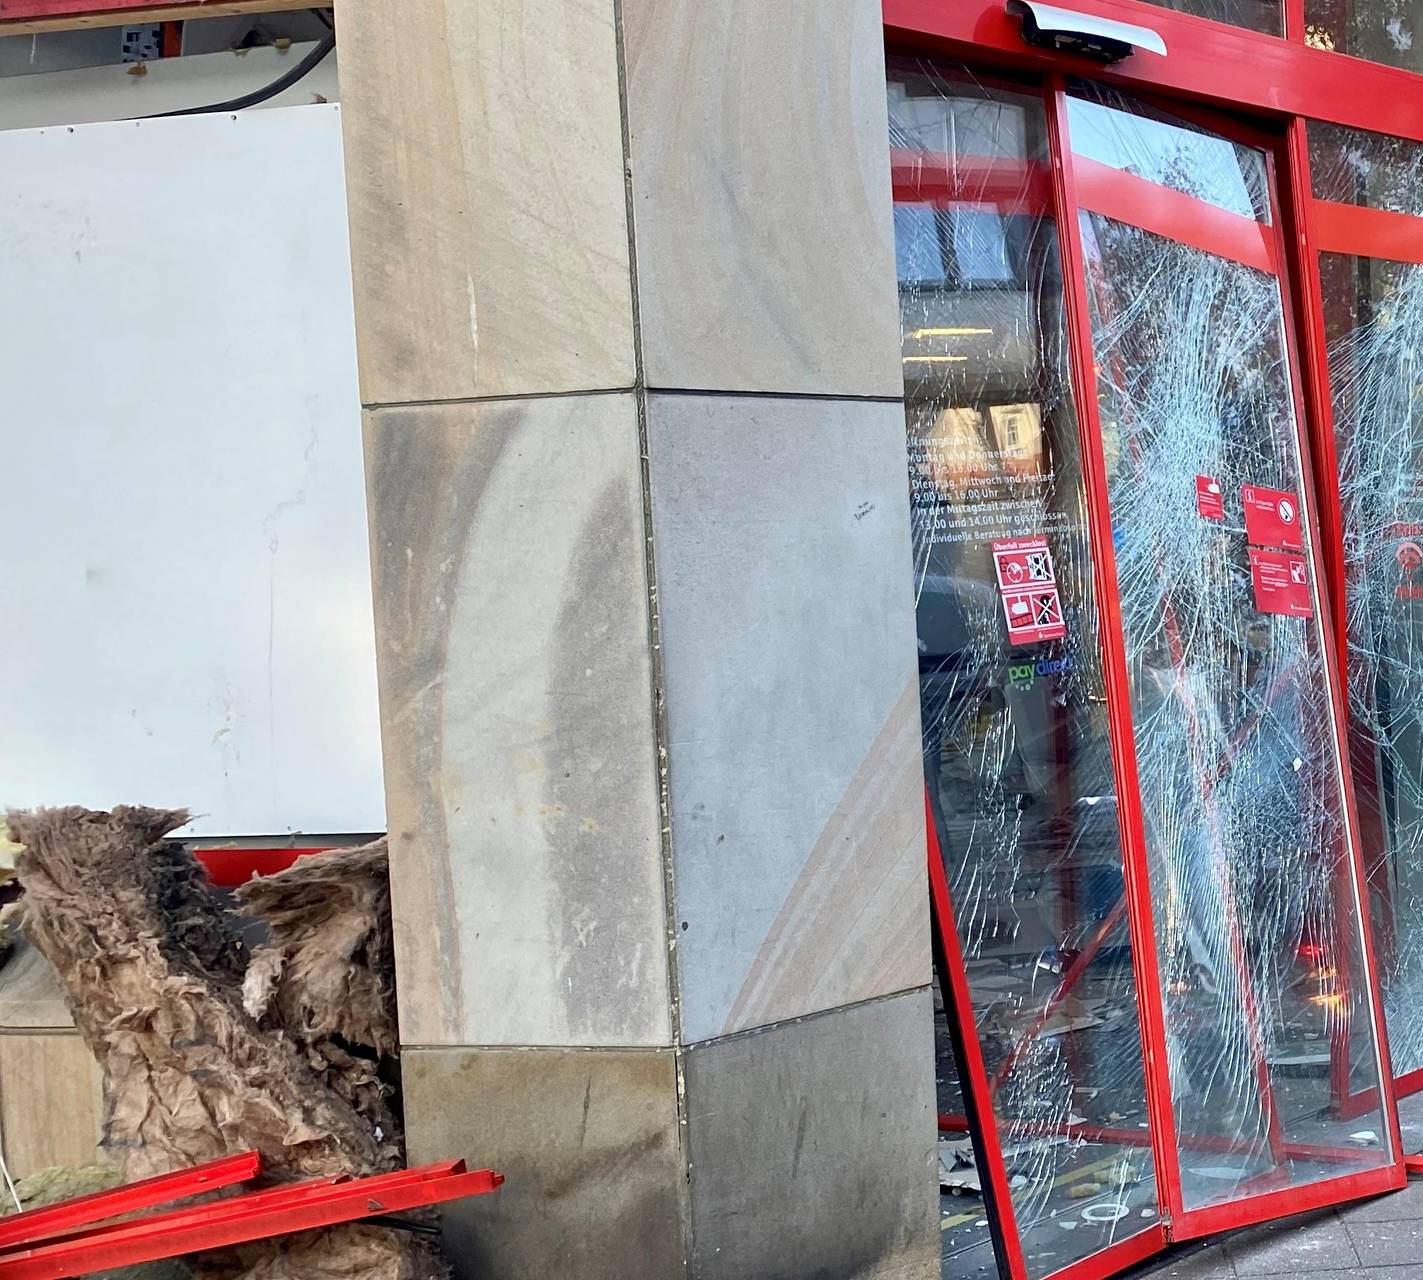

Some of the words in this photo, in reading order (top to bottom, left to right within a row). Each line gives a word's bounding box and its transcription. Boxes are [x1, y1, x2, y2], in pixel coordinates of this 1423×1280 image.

[981, 462, 999, 472] Uhr
[960, 475, 1002, 487] Mittwoch
[1003, 473, 1021, 483] und
[955, 488, 980, 500] 16.00
[982, 488, 999, 498] Uhr
[946, 501, 1000, 515] Mittagszeit
[1001, 499, 1042, 510] zwischen
[948, 517, 967, 529] und
[969, 515, 995, 527] 14.00
[996, 513, 1013, 524] Uhr
